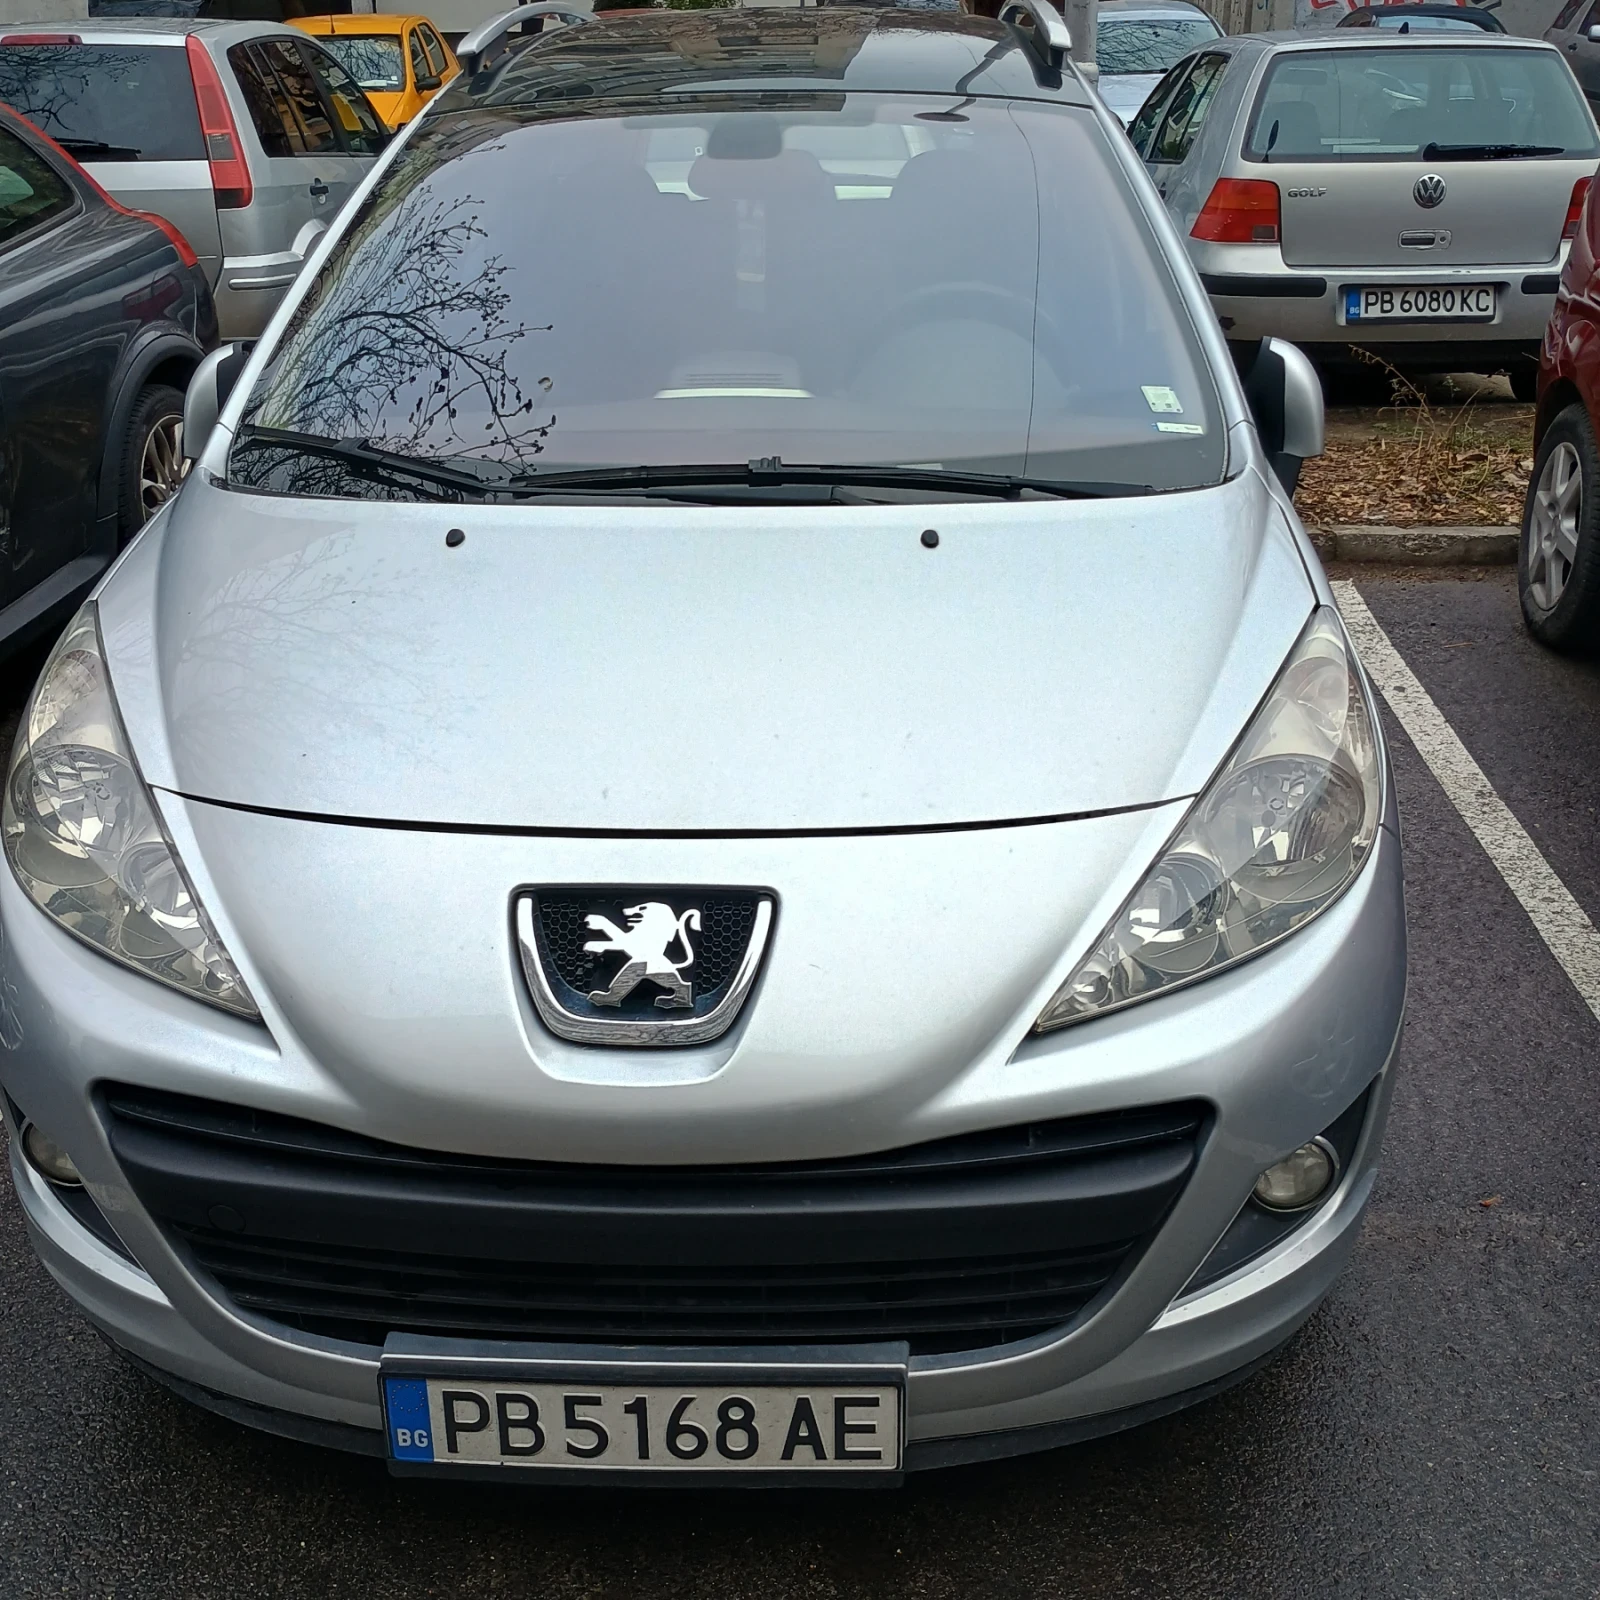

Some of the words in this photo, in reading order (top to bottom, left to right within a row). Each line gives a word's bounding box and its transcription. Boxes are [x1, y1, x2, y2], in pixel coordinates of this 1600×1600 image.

[1287, 187, 1328, 198] GOLF
[1349, 306, 1360, 314] BG
[1364, 291, 1395, 314] PB
[1400, 290, 1456, 313] 6080
[1460, 289, 1491, 313] KC
[441, 1389, 546, 1456] PB
[562, 1392, 760, 1461] 5168
[779, 1396, 883, 1461] AE
[396, 1428, 429, 1449] BG
